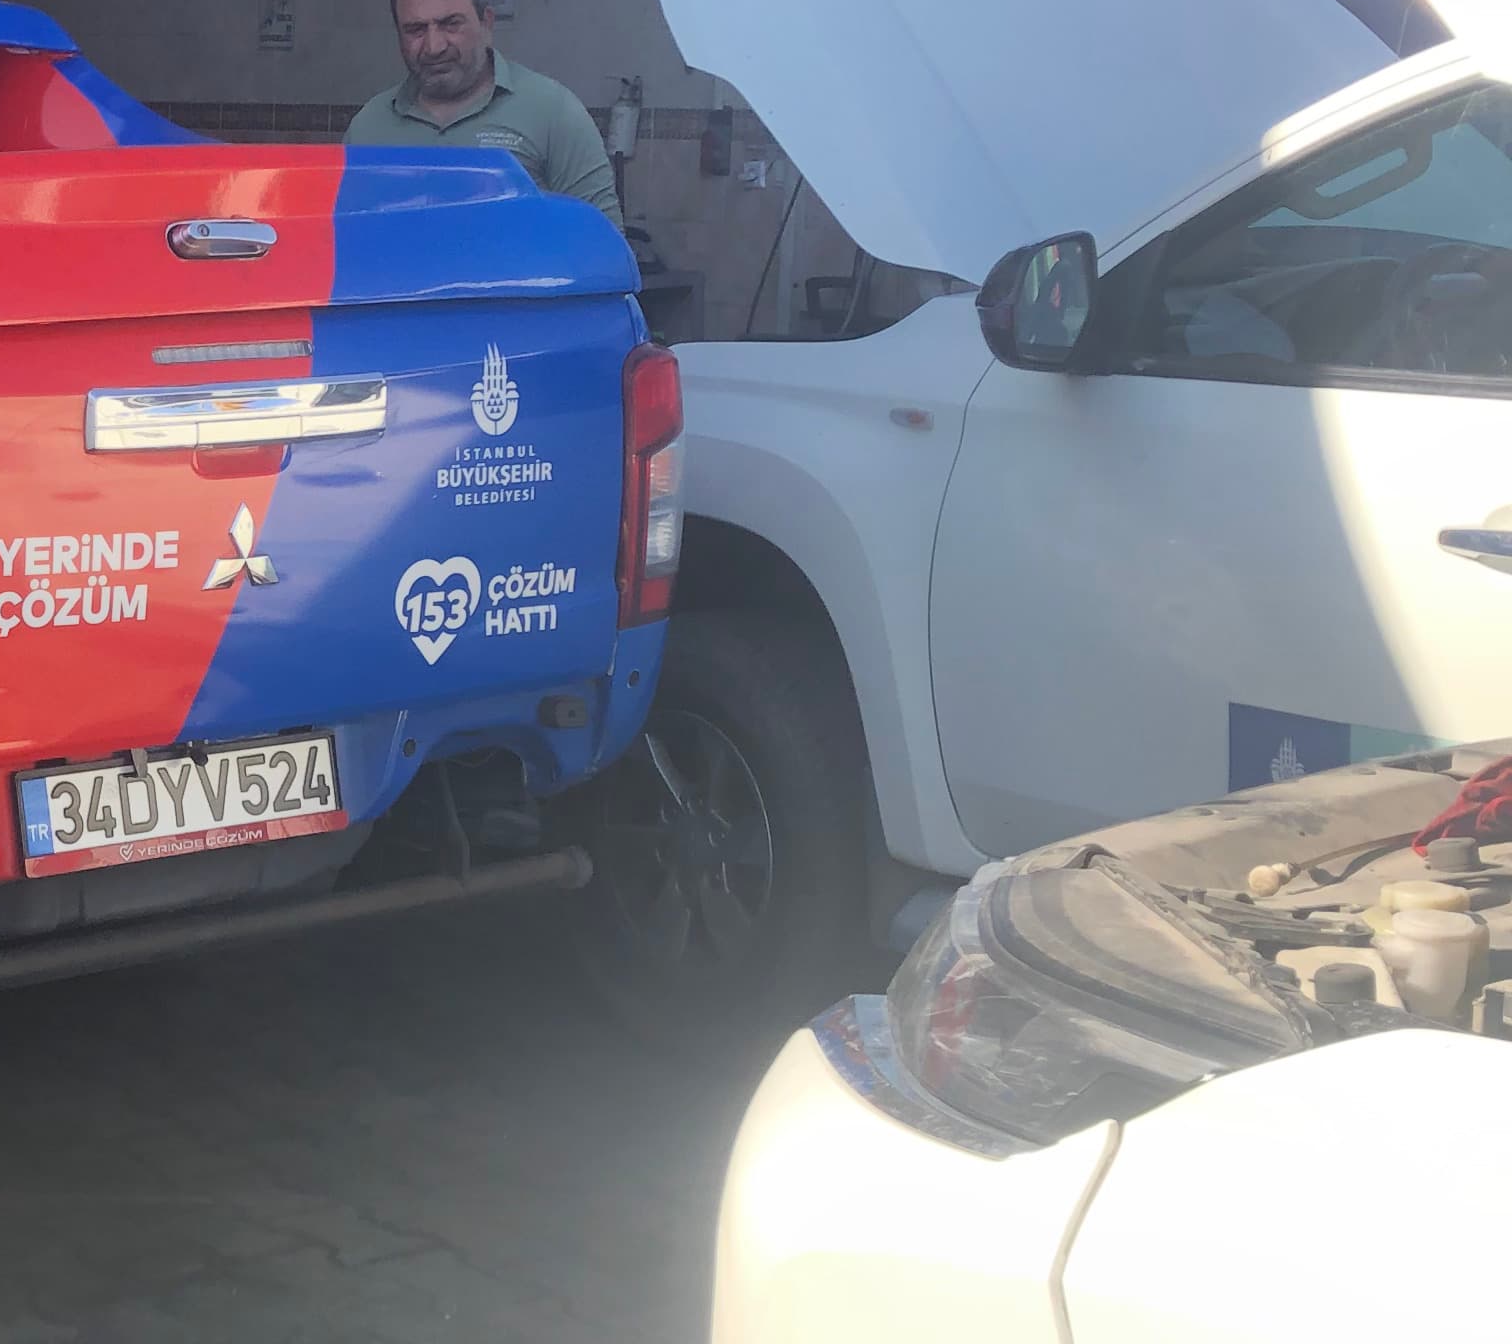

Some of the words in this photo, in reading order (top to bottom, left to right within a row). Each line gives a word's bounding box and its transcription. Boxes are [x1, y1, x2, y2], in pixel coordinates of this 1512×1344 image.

[455, 445, 537, 461] İSTANBUL
[437, 460, 553, 488] BÜYÜKŞEHİR
[455, 487, 535, 506] BELEDİYESİ
[488, 563, 576, 606] ÇÖZÜM
[406, 588, 469, 633] 153
[485, 605, 557, 636] HATTI
[27, 822, 50, 842] TR
[137, 838, 205, 857] YERİNDE
[205, 828, 263, 849] ÇÖZÜM
